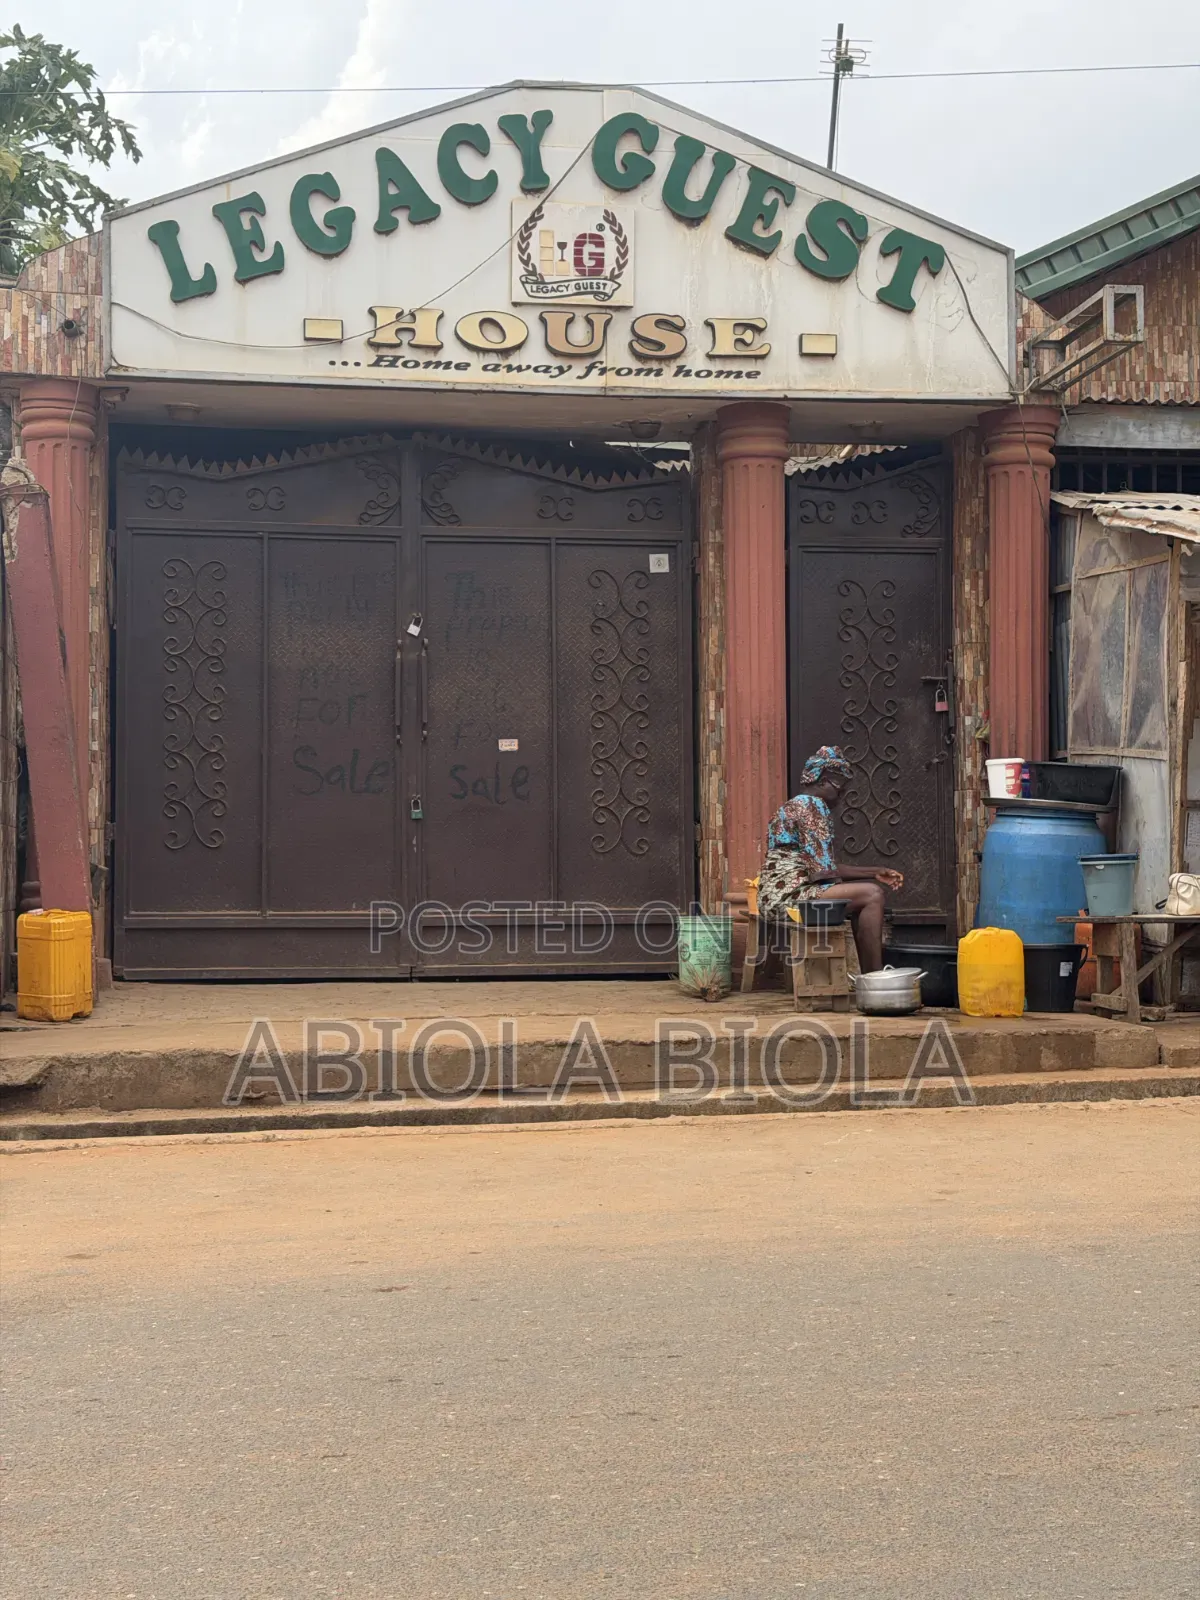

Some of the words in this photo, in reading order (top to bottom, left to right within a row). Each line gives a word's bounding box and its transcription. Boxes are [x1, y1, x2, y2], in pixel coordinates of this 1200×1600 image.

[147, 109, 554, 304] LEGACY
[591, 112, 946, 313] GUEST
[530, 283, 571, 295] LEGACY
[574, 281, 608, 291] GUEST
[367, 305, 771, 359] HOUSE
[481, 361, 573, 379] away
[576, 360, 664, 380] from
[672, 364, 762, 380] home
[292, 745, 392, 797] Sale
